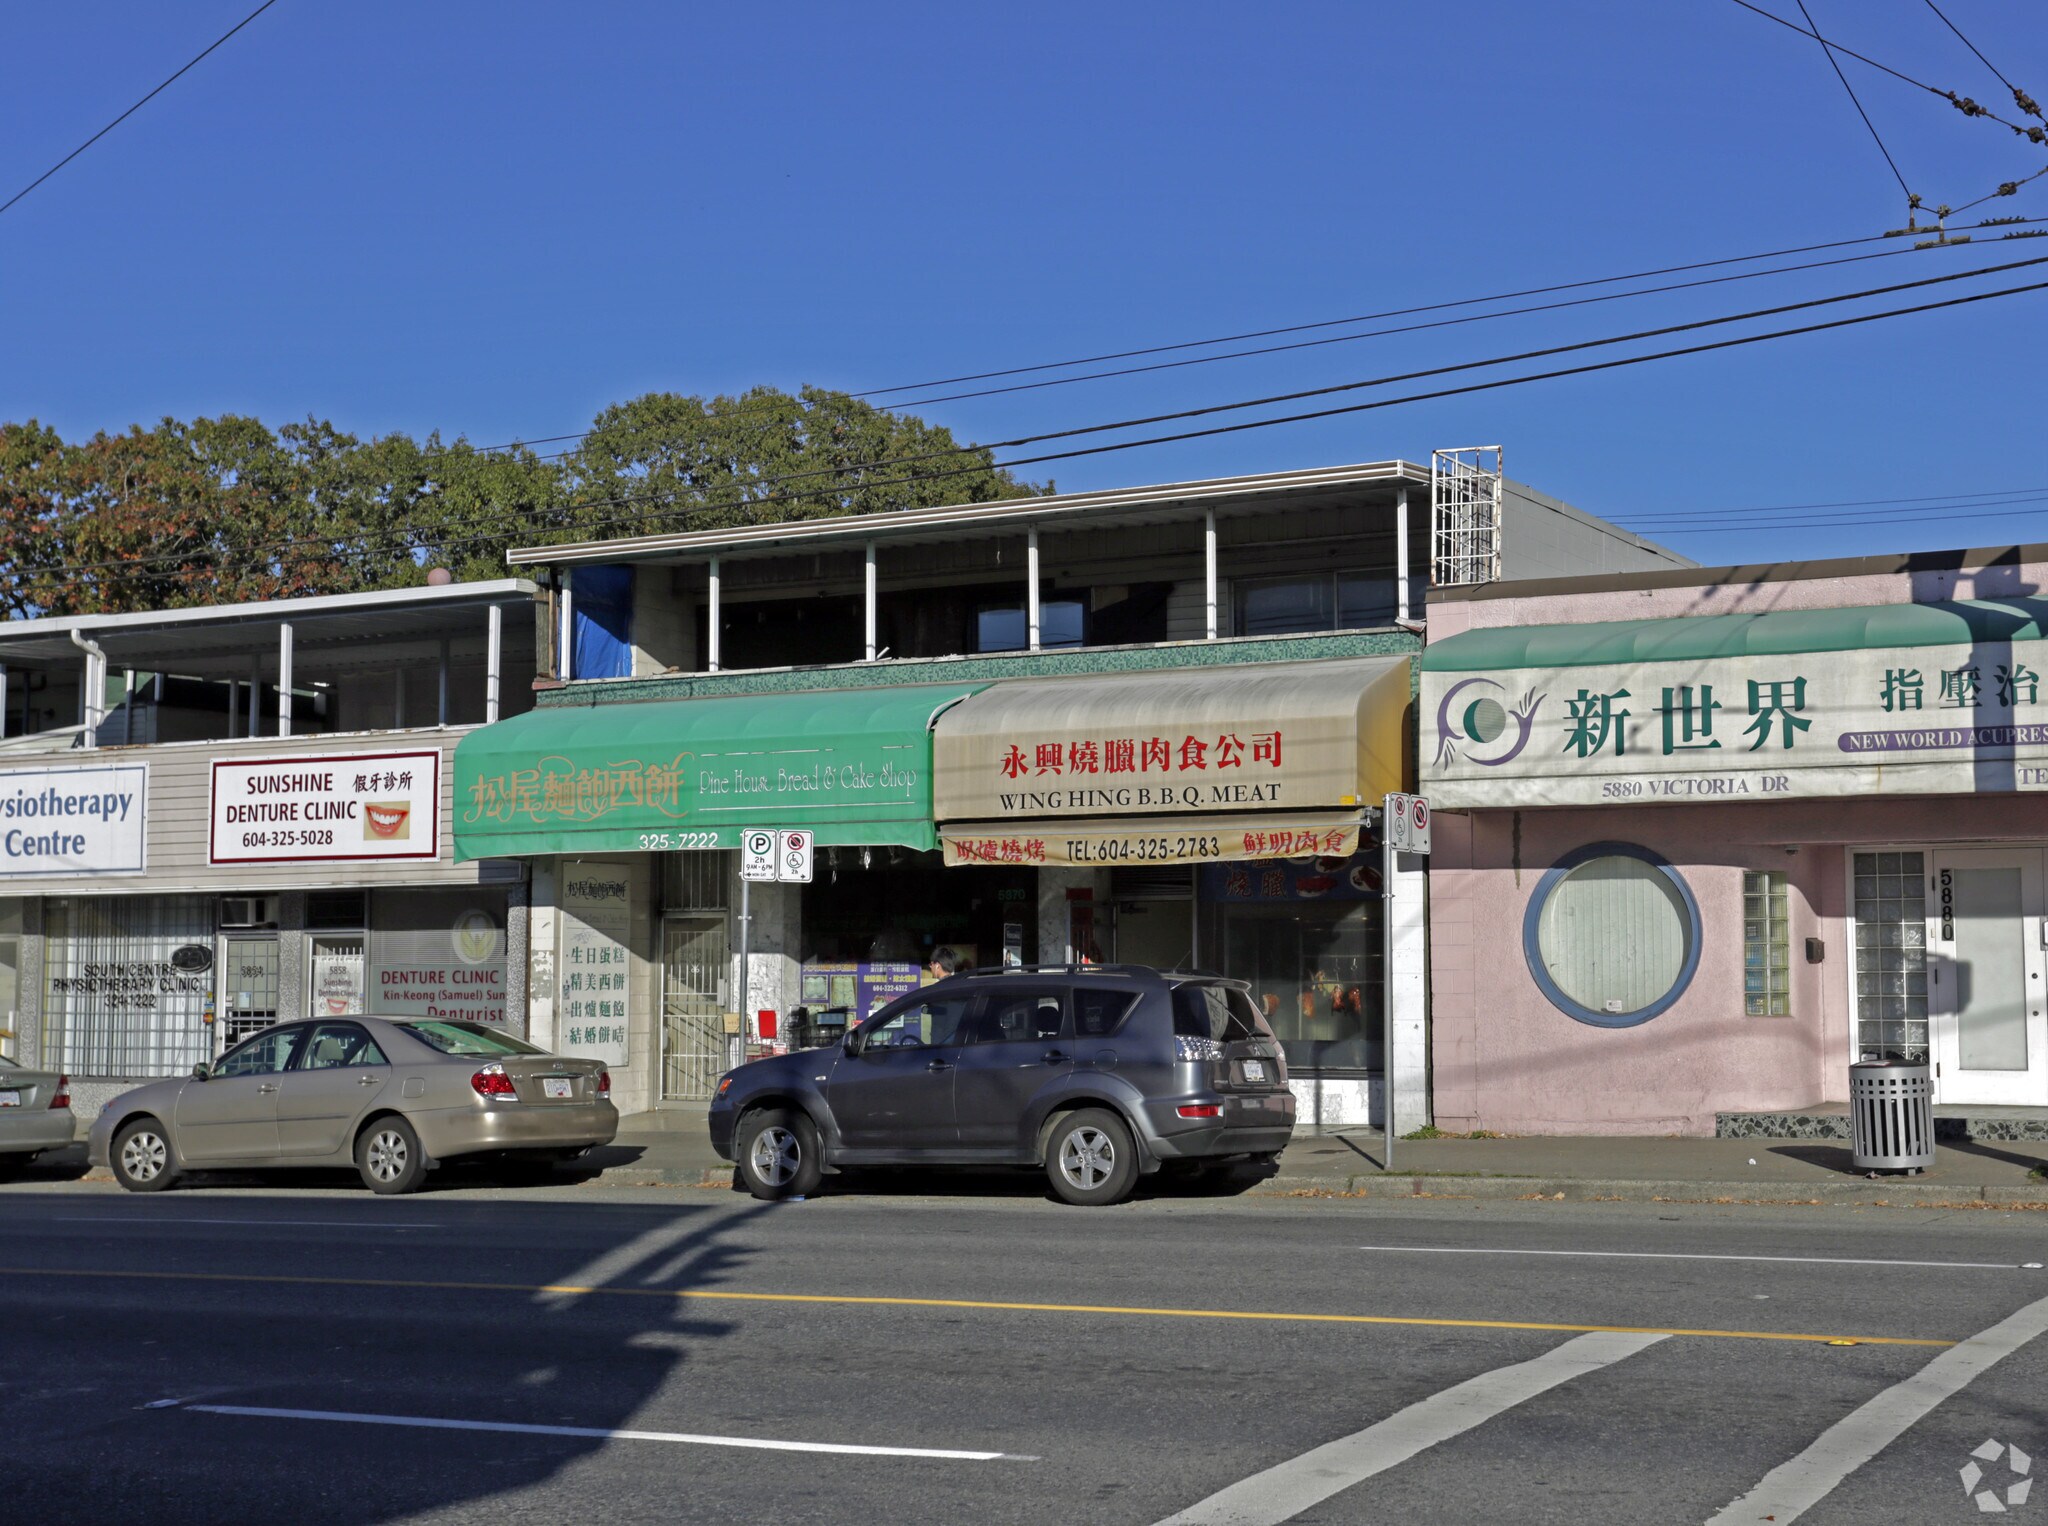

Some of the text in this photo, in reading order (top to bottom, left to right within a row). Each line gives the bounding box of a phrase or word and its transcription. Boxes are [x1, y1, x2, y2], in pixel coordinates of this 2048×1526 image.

[1879, 664, 2040, 713] 指壓治
[1562, 676, 1812, 758] 新世界
[1850, 732, 1889, 751] NEW
[1894, 731, 1962, 748] WORLD
[999, 730, 1282, 779] 永興燒臘肉食公司
[247, 773, 333, 795] SUNSHINE
[352, 770, 413, 793] 假牙診所
[700, 761, 917, 797] Pine House Bread & Cake Shop
[2018, 768, 2048, 784] TE
[1602, 776, 1789, 798] 5880 VICTORIA DR
[999, 783, 1281, 811] WING HING B.B.Q. MEAT
[226, 801, 357, 823] DENTURE CLINIC
[5, 829, 86, 857] Centre
[242, 830, 333, 848] 604-325-5028
[639, 832, 718, 850] 325-7222
[756, 837, 766, 850] P
[1243, 829, 1346, 856] 鮮明肉食
[1941, 870, 1954, 940] 5880
[570, 946, 625, 965] 生日蛋糕
[84, 963, 177, 978] SOUTH CENTRE
[329, 965, 347, 975] 5858
[381, 970, 499, 984] DENTURE CLINIC
[53, 977, 200, 993] PHYSIOTHERAPY CLINIC
[324, 978, 352, 987] Sunshine
[570, 973, 625, 991] 精美西餅
[383, 990, 435, 1002] Kin-Keong
[438, 990, 482, 1001] (Samuel)
[427, 1006, 503, 1021] Denturist
